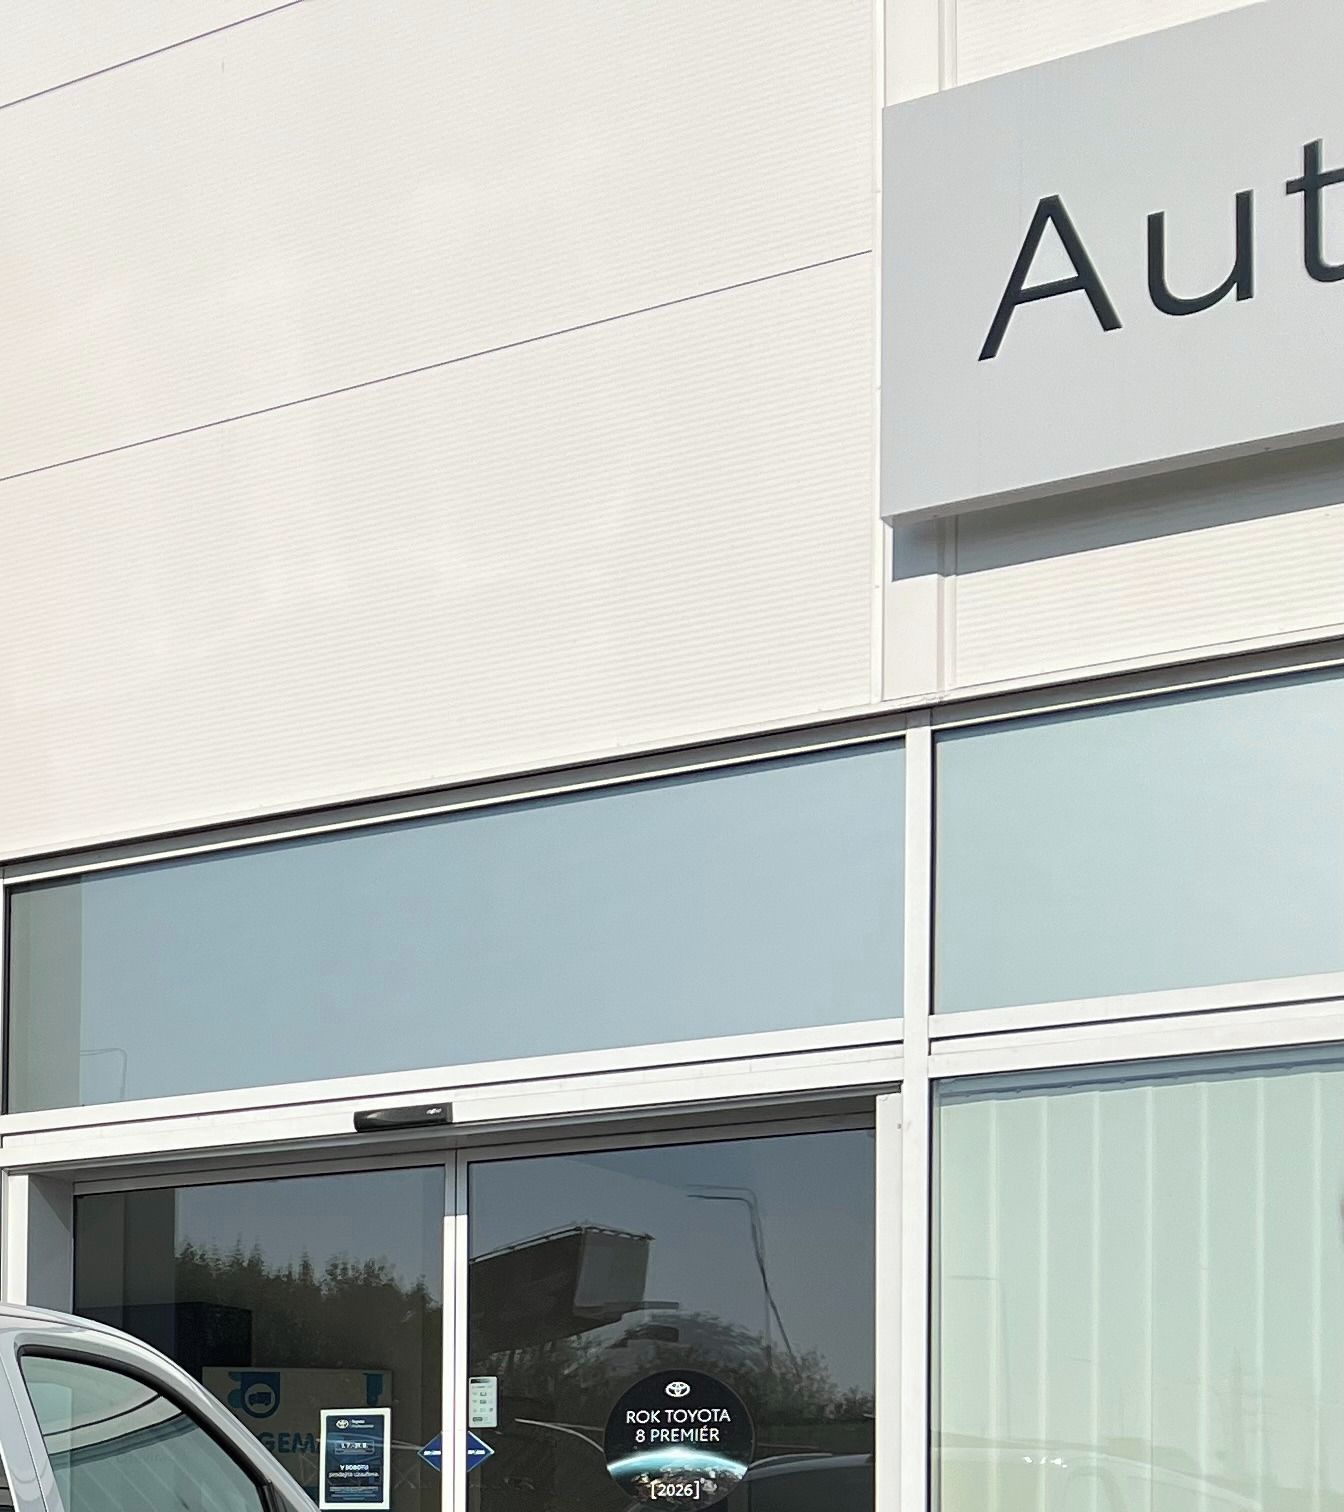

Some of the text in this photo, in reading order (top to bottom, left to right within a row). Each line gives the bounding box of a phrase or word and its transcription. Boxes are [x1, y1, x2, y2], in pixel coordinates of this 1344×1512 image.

[626, 1408, 732, 1424] ROK TOYOTA
[635, 1424, 720, 1443] 8 PREMIÉR
[650, 1480, 700, 1500] [2026]
